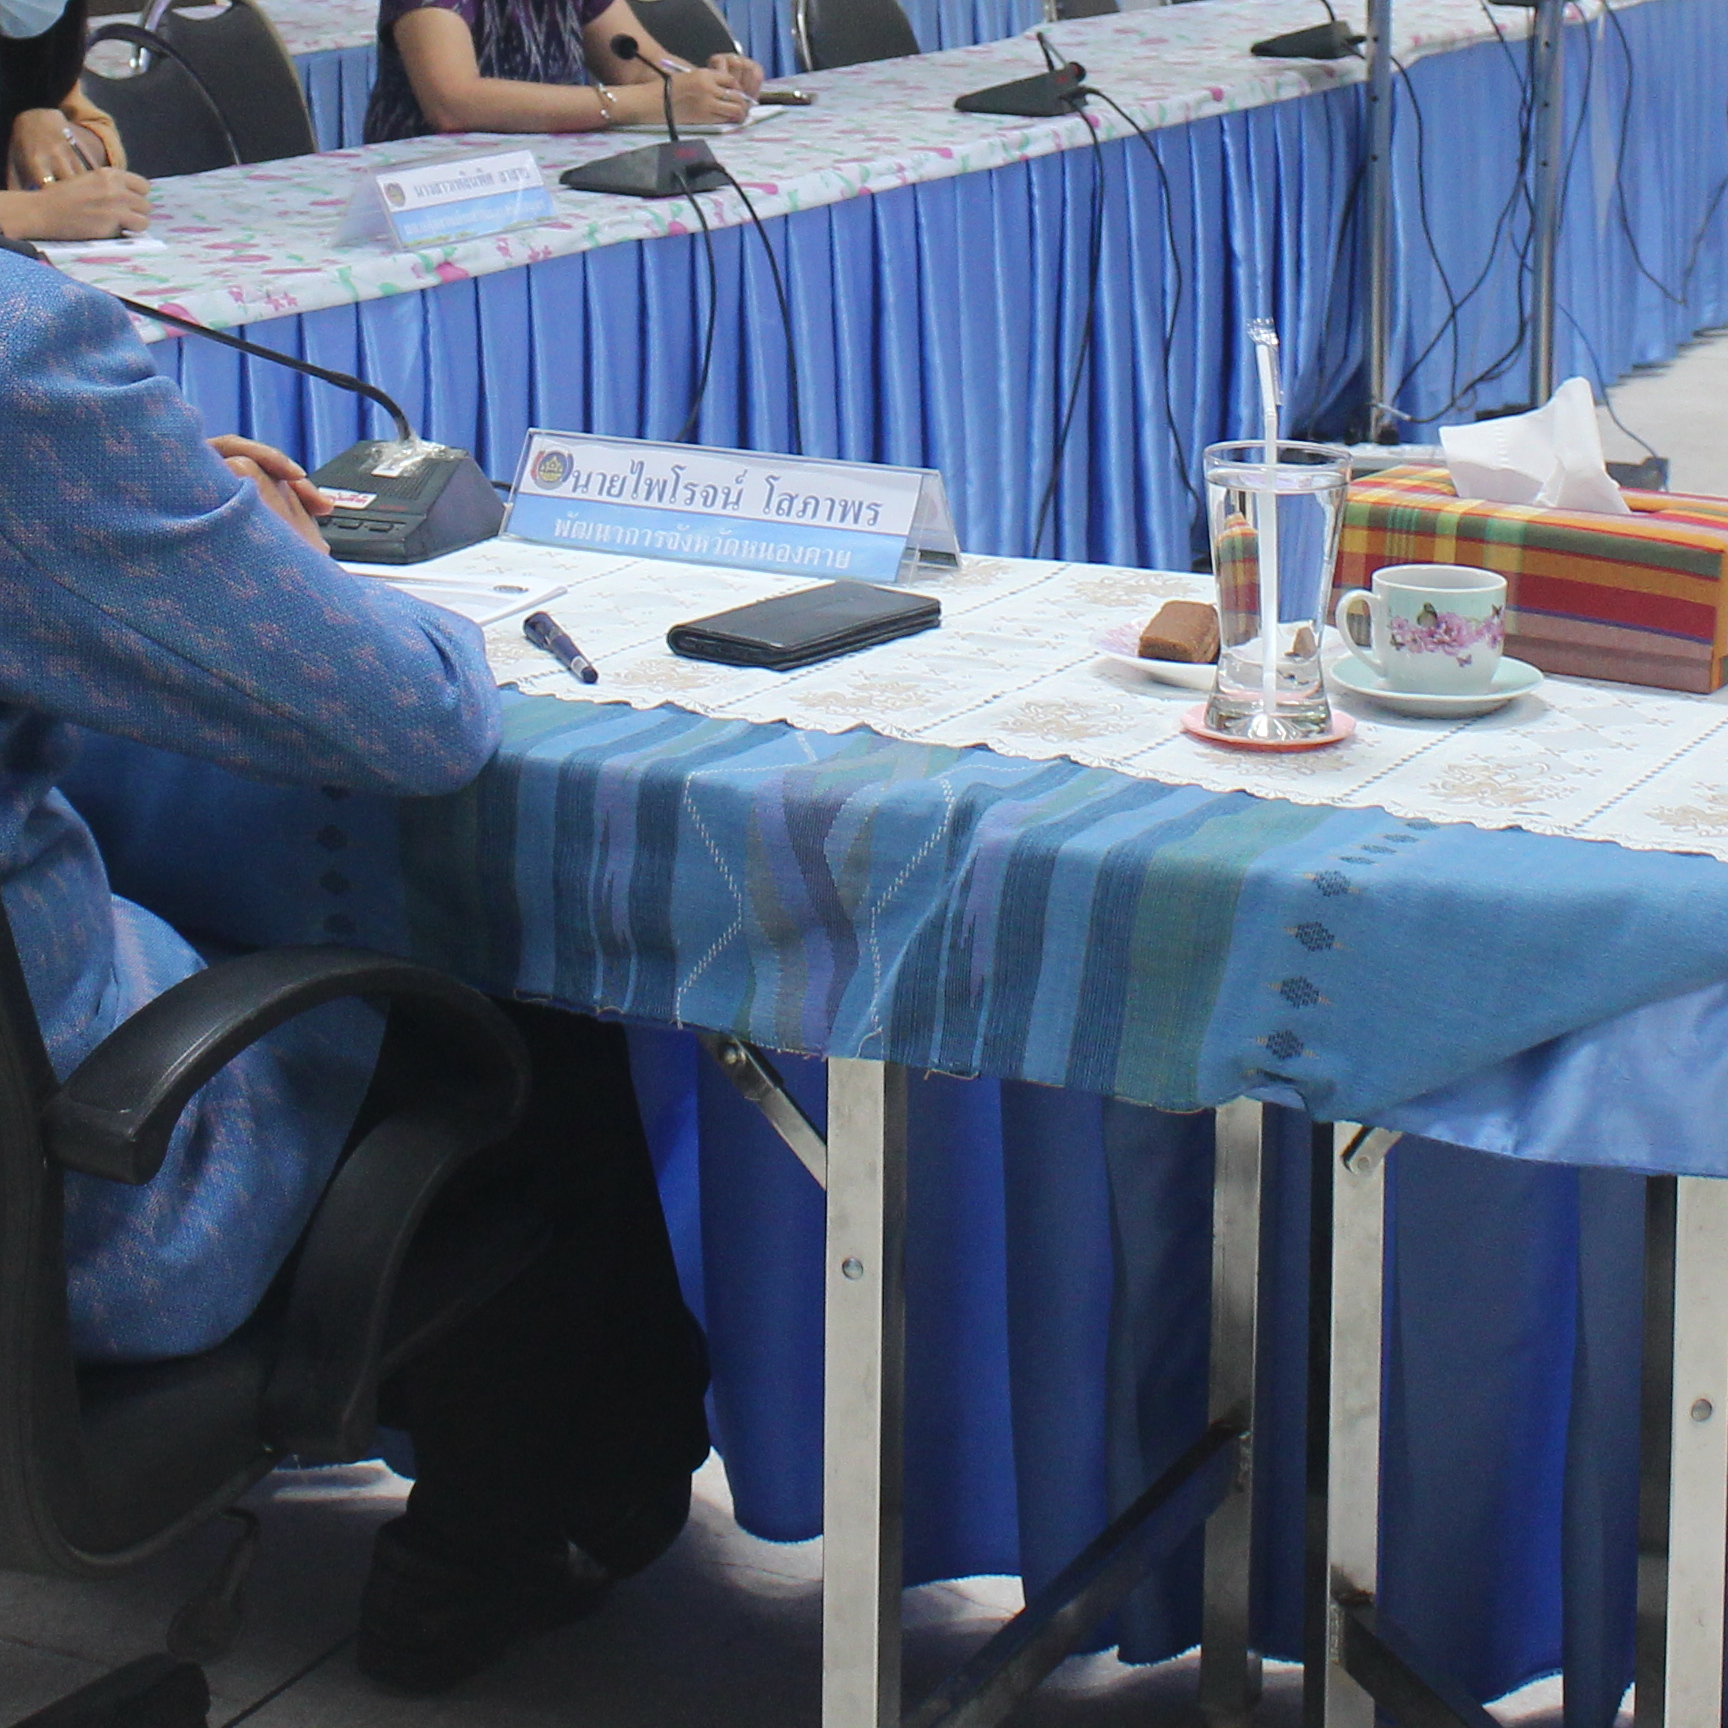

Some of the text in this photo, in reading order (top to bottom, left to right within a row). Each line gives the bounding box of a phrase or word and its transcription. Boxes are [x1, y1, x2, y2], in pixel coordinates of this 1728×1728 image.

[571, 459, 884, 528] นายไพโรจน์ โสภาพร
[553, 510, 852, 570] พัฒนาการจังหวัดหนองคาย
